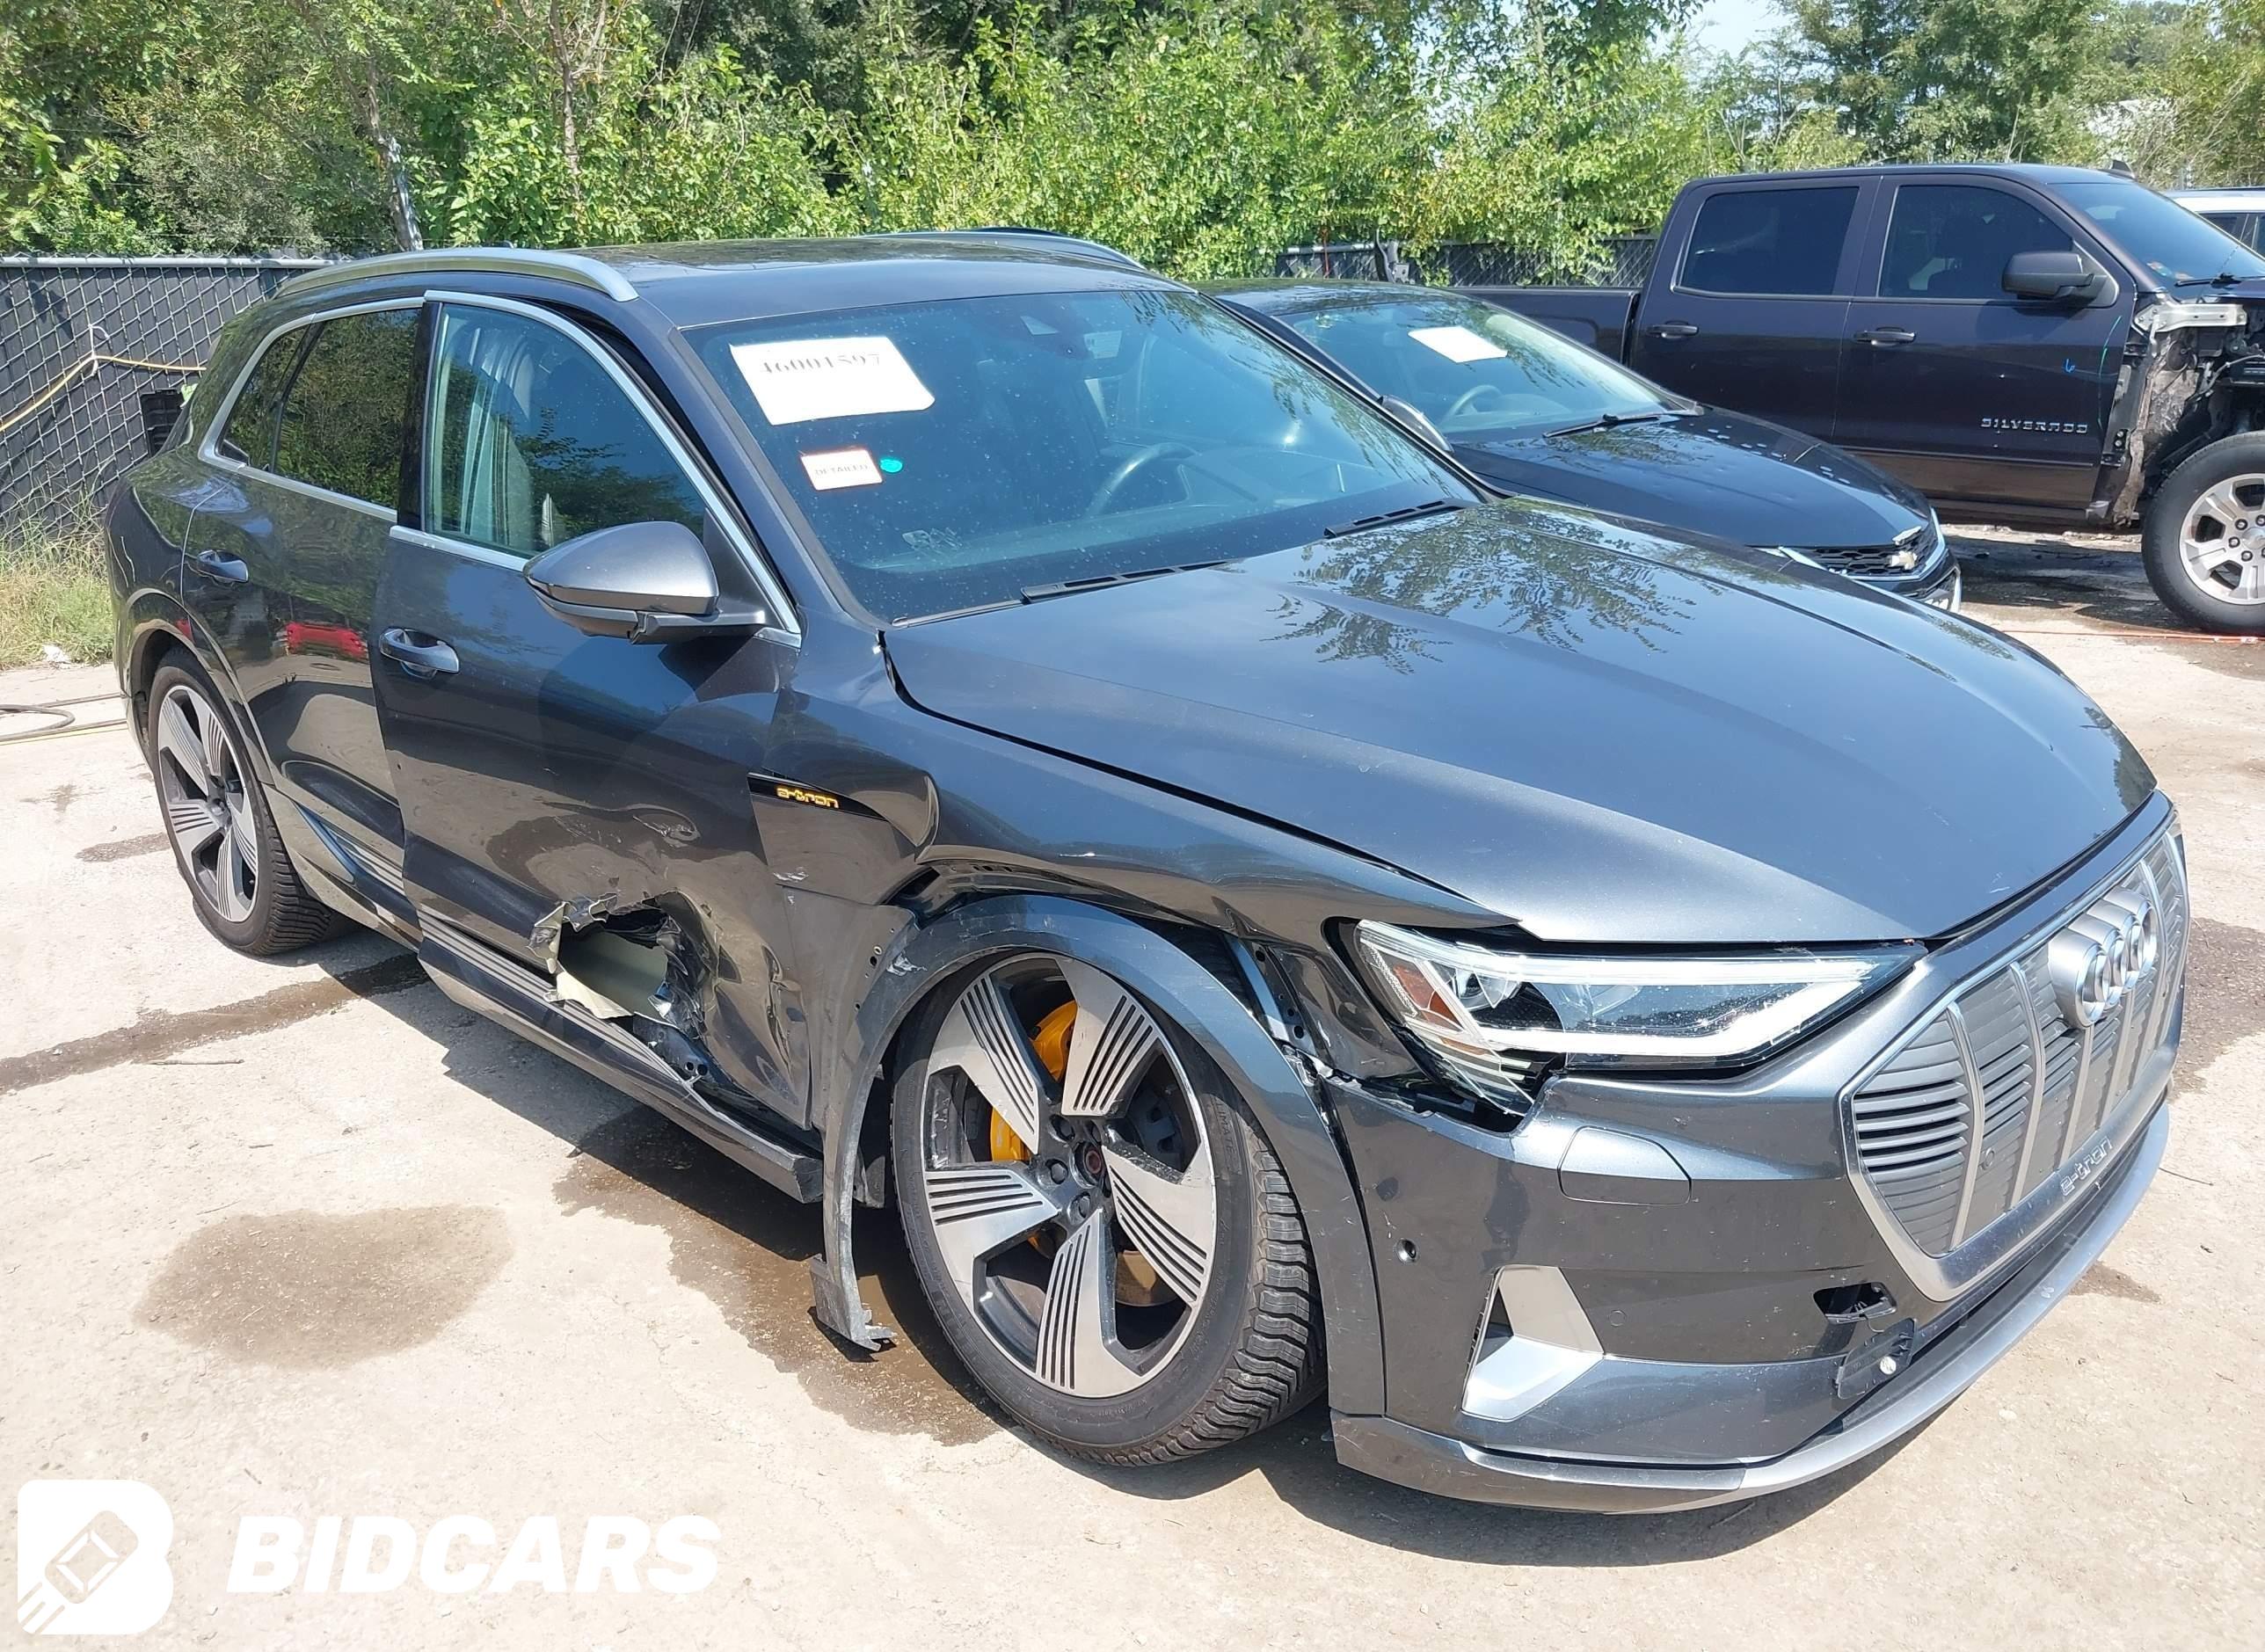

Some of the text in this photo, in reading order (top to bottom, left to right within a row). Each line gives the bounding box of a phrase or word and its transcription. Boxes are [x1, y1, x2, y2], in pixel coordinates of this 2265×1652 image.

[1980, 418, 2088, 433] SILVERADO
[776, 787, 840, 809] e-tron
[2060, 1136, 2113, 1197] e-tron
